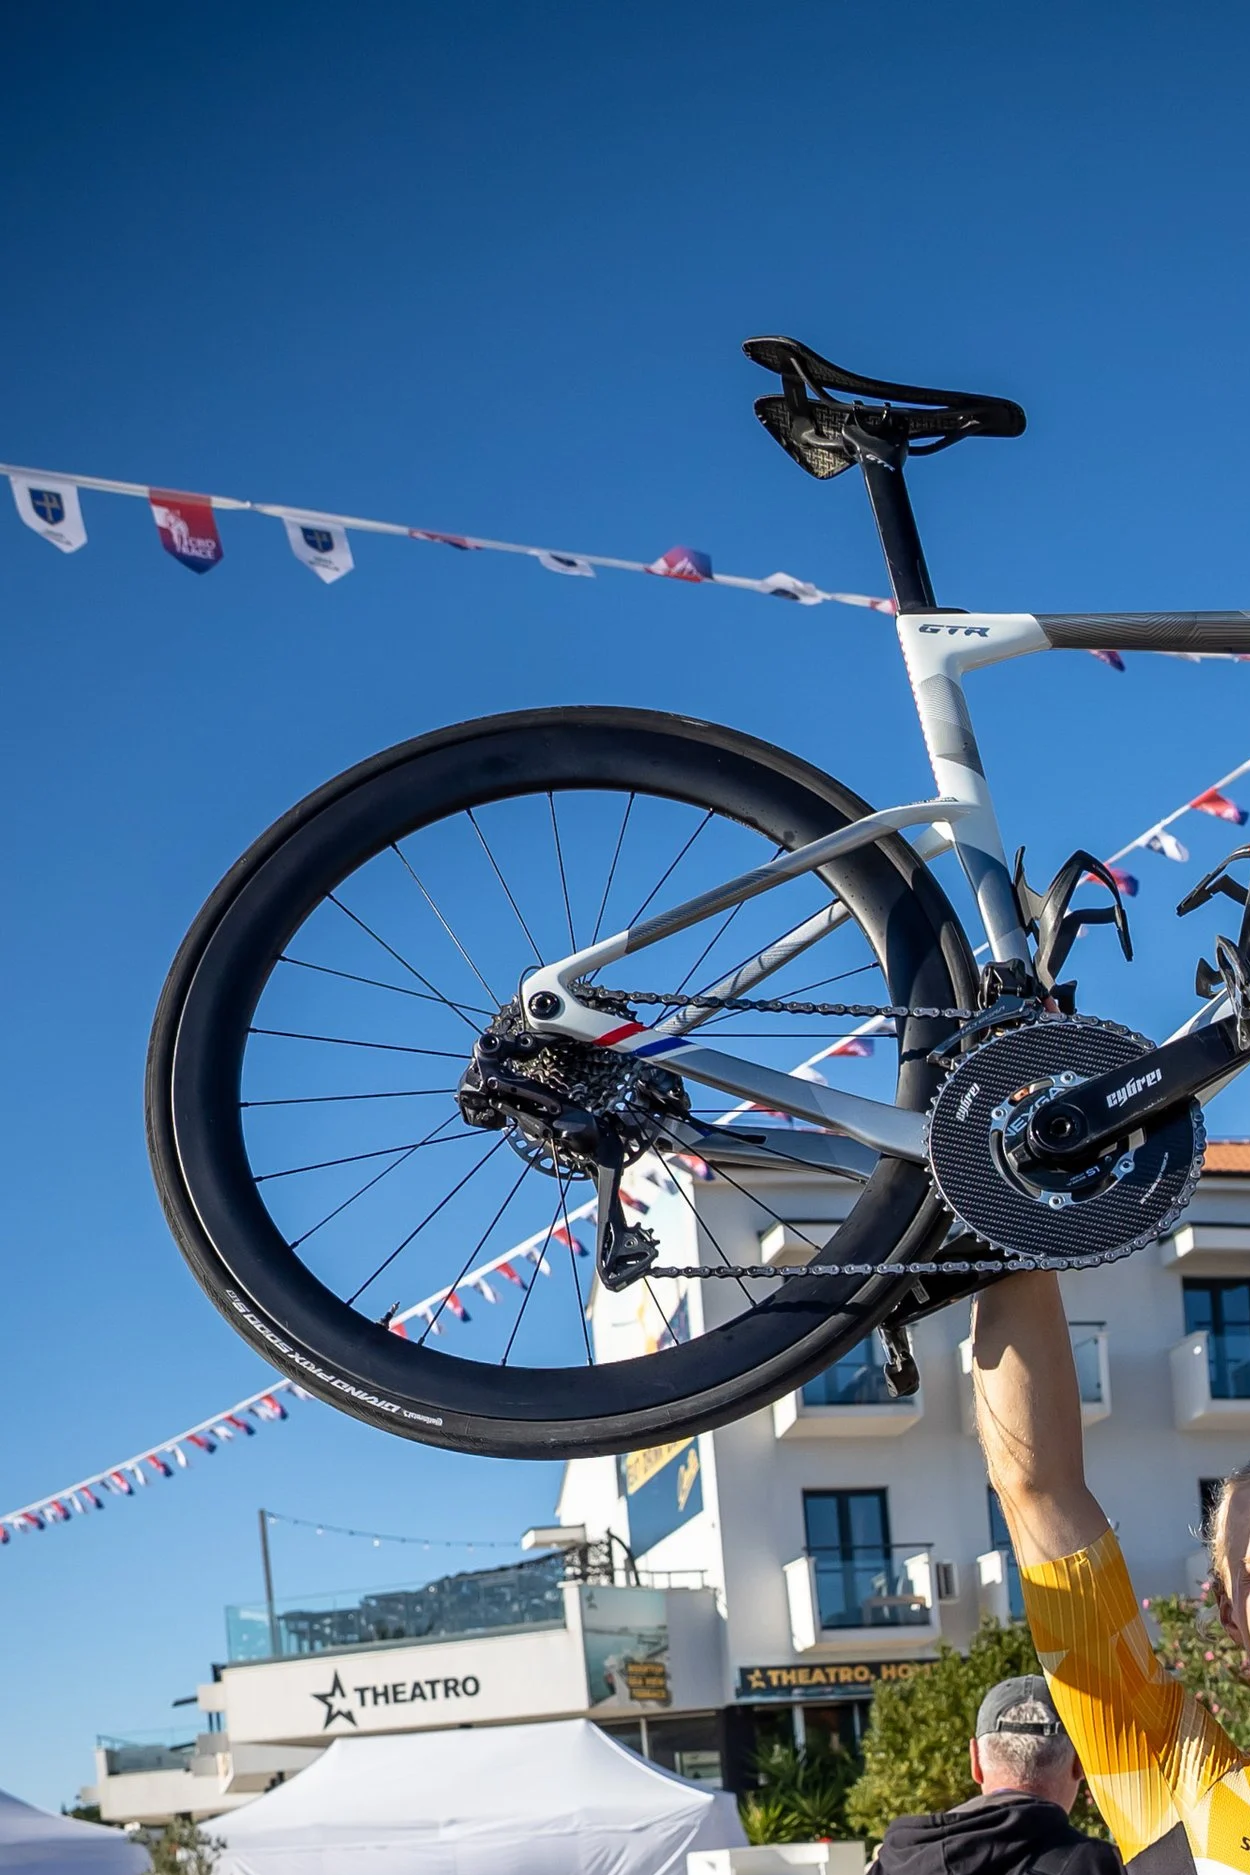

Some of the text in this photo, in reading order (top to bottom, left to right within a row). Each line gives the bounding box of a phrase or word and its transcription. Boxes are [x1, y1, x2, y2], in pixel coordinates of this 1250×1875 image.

[866, 453, 896, 472] GTR
[918, 623, 990, 638] GTR
[242, 1312, 294, 1354] 5000
[288, 1350, 336, 1385] PRIX
[329, 1379, 402, 1413] GRAND
[354, 1675, 481, 1707] THEATRO
